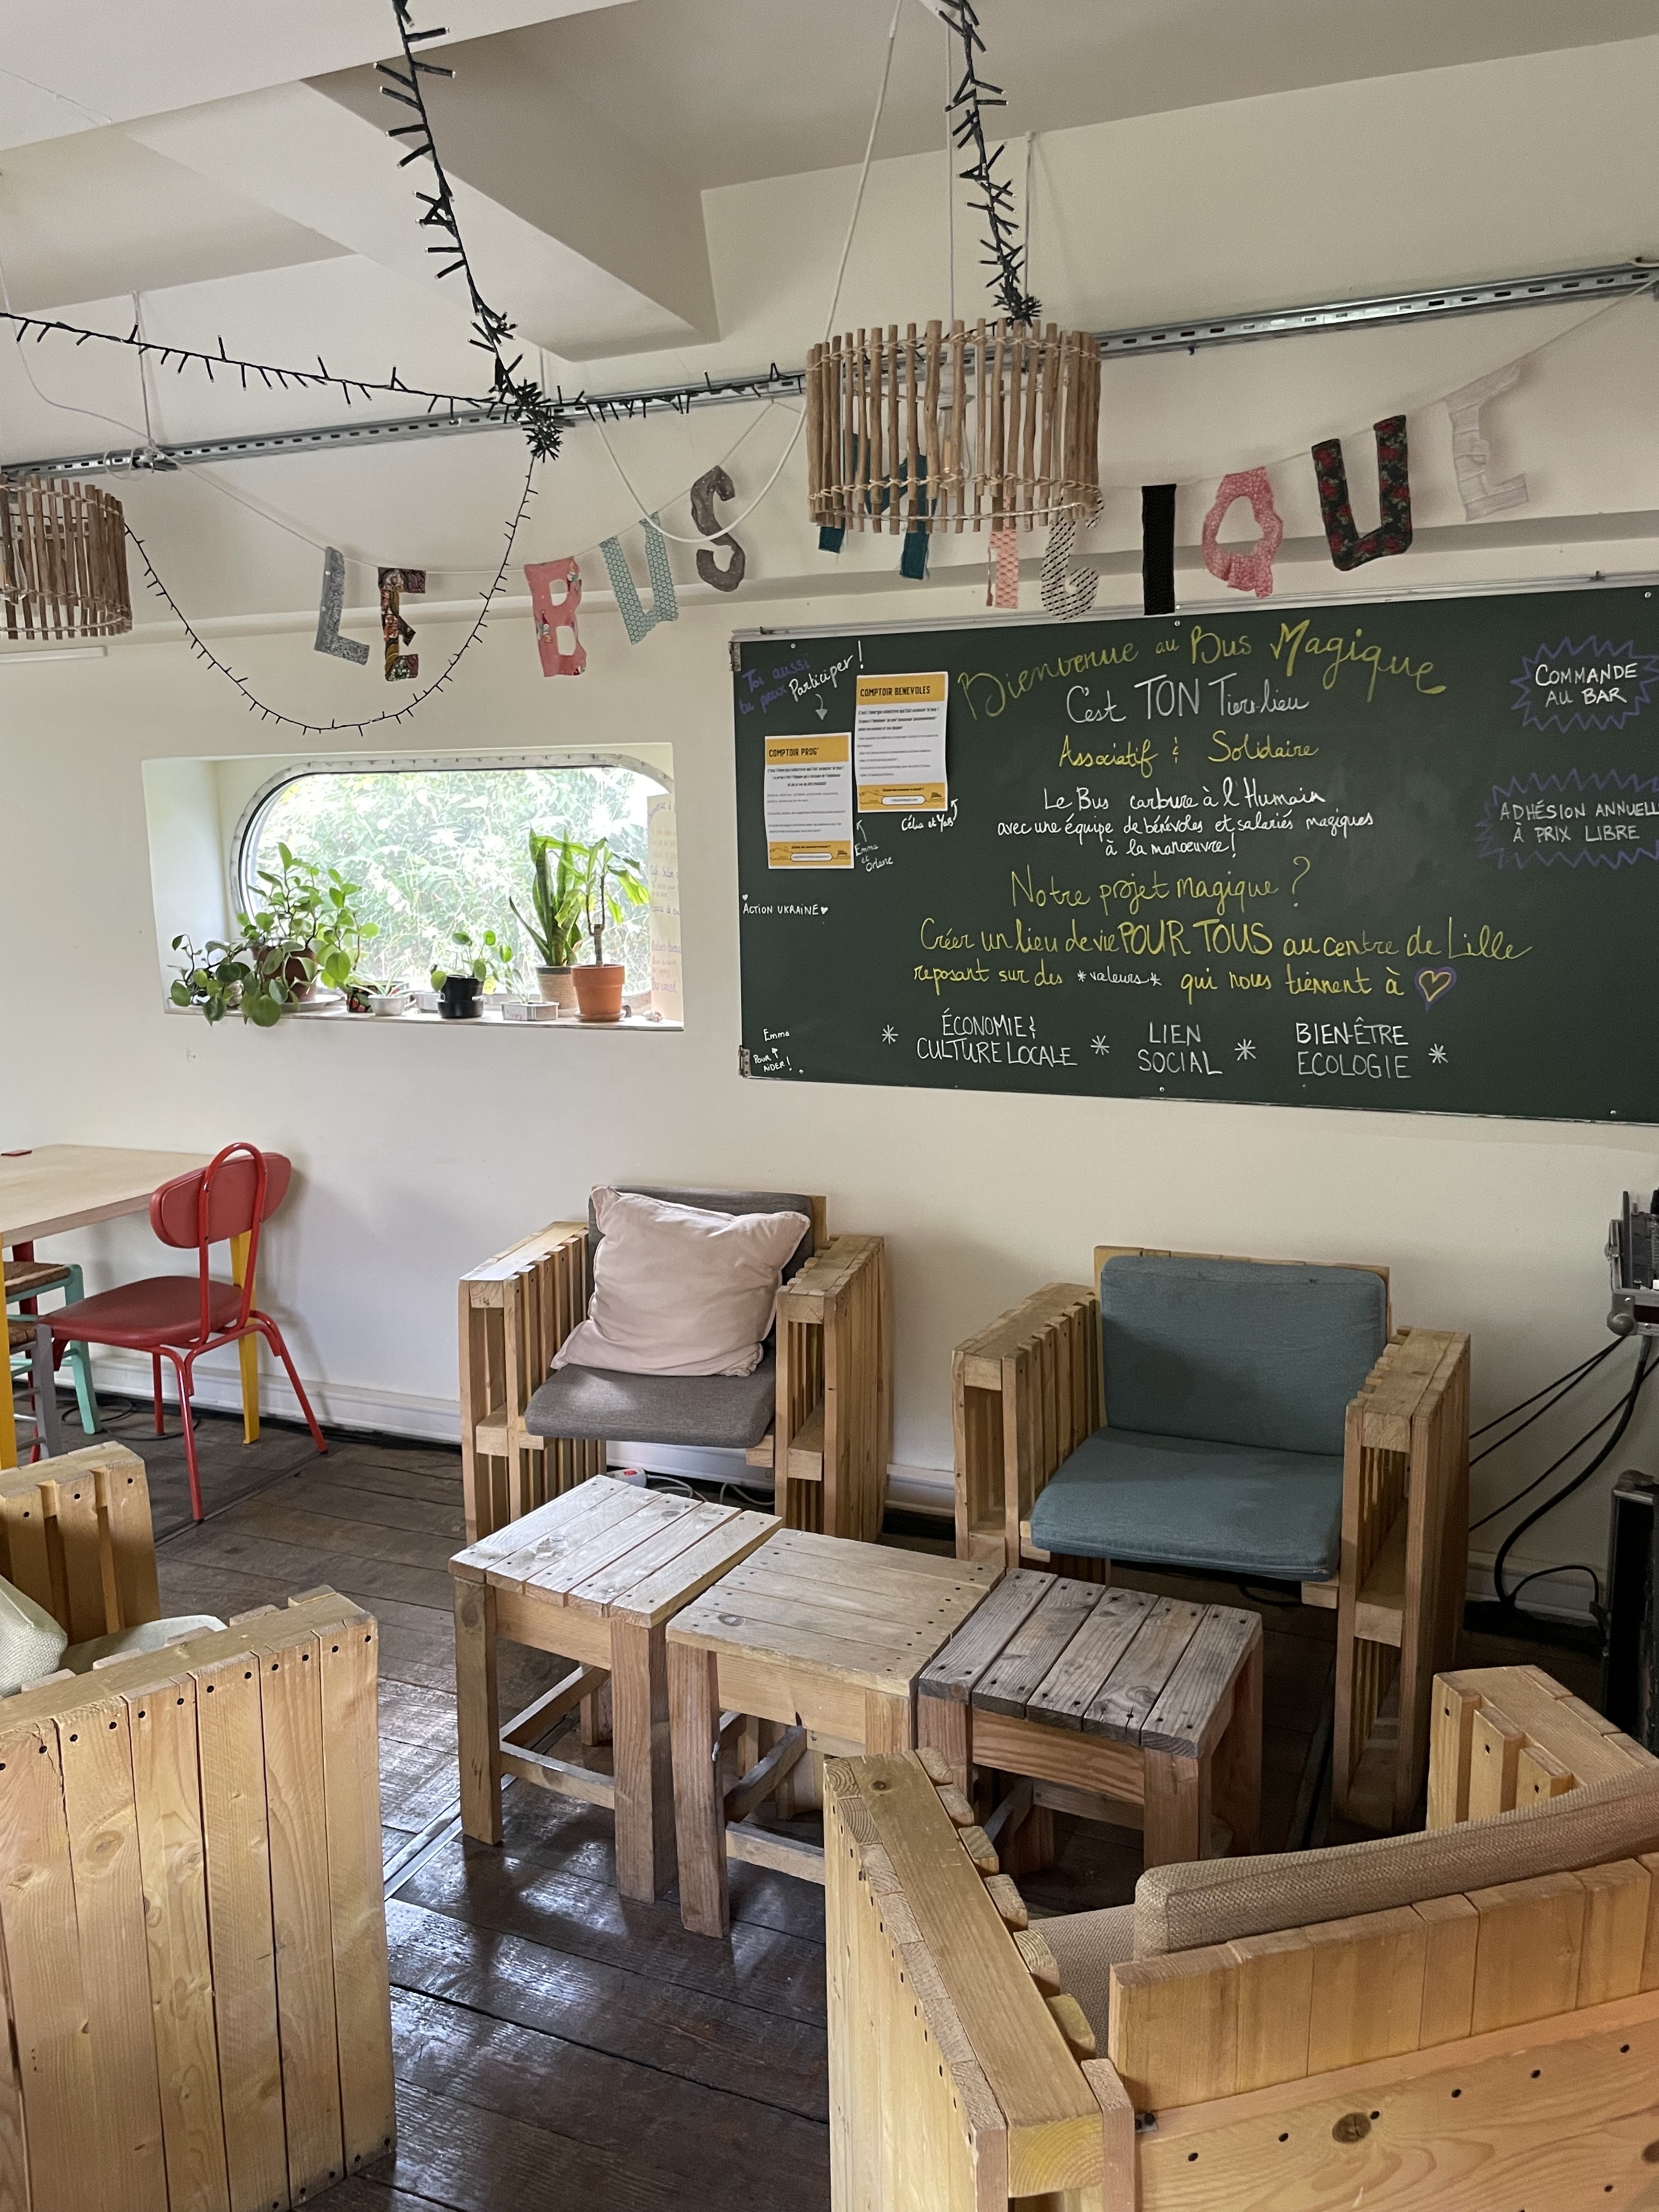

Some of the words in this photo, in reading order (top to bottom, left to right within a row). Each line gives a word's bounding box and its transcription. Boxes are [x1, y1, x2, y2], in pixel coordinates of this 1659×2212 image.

[314, 546, 426, 681] LE
[523, 465, 746, 678] BUS
[772, 659, 810, 680] aussi
[957, 643, 1139, 720] Bienvenue
[1155, 639, 1180, 654] au
[1191, 625, 1252, 664] Bus
[1270, 619, 1447, 703] Magique
[1535, 662, 1639, 686] COMMANDE
[760, 685, 787, 713] peux
[860, 687, 893, 697] COMPTOIR
[895, 686, 930, 696] BENEVOLES
[1066, 685, 1126, 723] C'est
[1134, 674, 1200, 720] TON
[1545, 690, 1573, 708] AU
[1581, 687, 1627, 705] BAR
[769, 748, 799, 757] COMPTOIR
[1059, 735, 1158, 778] Associatif
[1208, 730, 1319, 762] Solidaire
[1044, 788, 1073, 810] Le
[1076, 787, 1109, 811] Bus
[1130, 787, 1199, 810] carbure
[1203, 786, 1218, 807] à
[1500, 799, 1585, 821] ADHÉSION
[1595, 800, 1659, 817] ANNUELL
[928, 817, 936, 828] et
[998, 821, 1032, 836] avec
[1035, 821, 1062, 833] une
[1064, 814, 1114, 845] équipe
[1123, 815, 1143, 834] de
[1143, 814, 1203, 834] bénévoles
[1215, 814, 1236, 833] et
[1237, 809, 1294, 832] salariés
[1305, 809, 1374, 838] magiques
[1534, 825, 1571, 843] PRIX
[1584, 825, 1640, 842] LIBRE
[1105, 840, 1118, 856] à
[1126, 838, 1147, 856] la
[1012, 865, 1090, 907] Notre
[1099, 871, 1170, 916] projet
[1177, 871, 1278, 916] magique
[921, 918, 975, 950] Créer
[981, 930, 1013, 952] un
[1015, 918, 1058, 953] lieu
[1065, 919, 1093, 952] de
[1093, 929, 1119, 952] vie
[1117, 918, 1191, 956] POUR
[1193, 918, 1273, 955] TOUS
[1283, 937, 1321, 956] au
[1323, 930, 1400, 957] centre
[1407, 925, 1442, 956] de
[1448, 917, 1533, 960] Lille
[913, 958, 990, 996] reposant
[998, 969, 1030, 983] sur
[1035, 958, 1063, 986] des
[1181, 967, 1217, 1005] qui
[1229, 971, 1272, 990] nous
[1385, 967, 1404, 995] à
[763, 1029, 790, 1041] Emma
[942, 1008, 1027, 1037] ÉCONOMIE
[1149, 1022, 1201, 1046] LIEN
[1296, 1016, 1409, 1046] BIEN-ÊTRE
[917, 1037, 1002, 1064] CULTURE
[1007, 1041, 1078, 1067] LOCALE
[1138, 1049, 1223, 1075] SOCIAL
[1297, 1051, 1412, 1079] ECOLOGIE
